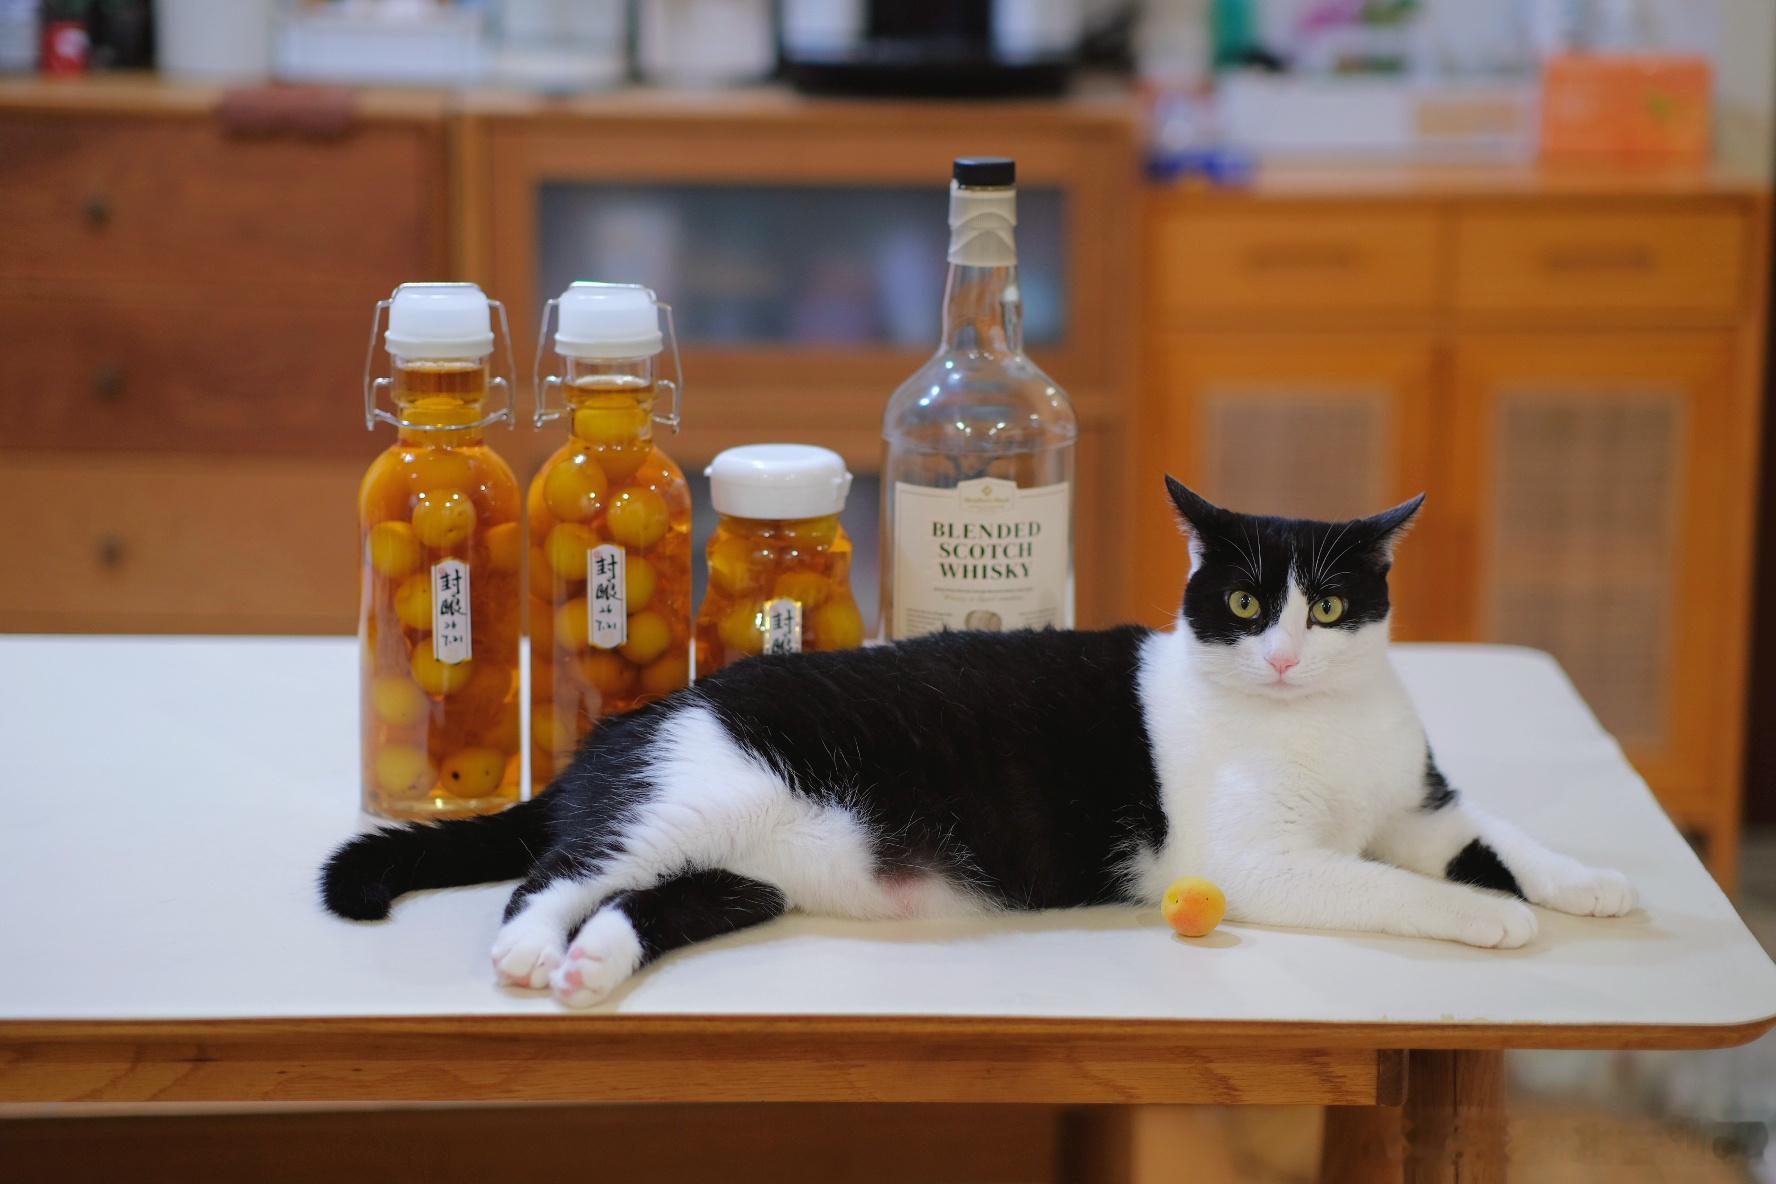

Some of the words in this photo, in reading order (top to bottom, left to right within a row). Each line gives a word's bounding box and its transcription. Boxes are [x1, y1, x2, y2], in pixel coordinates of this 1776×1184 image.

[932, 521, 1041, 539] BLENDED
[939, 541, 1033, 560] SCOTCH
[938, 562, 1032, 580] WHISKY
